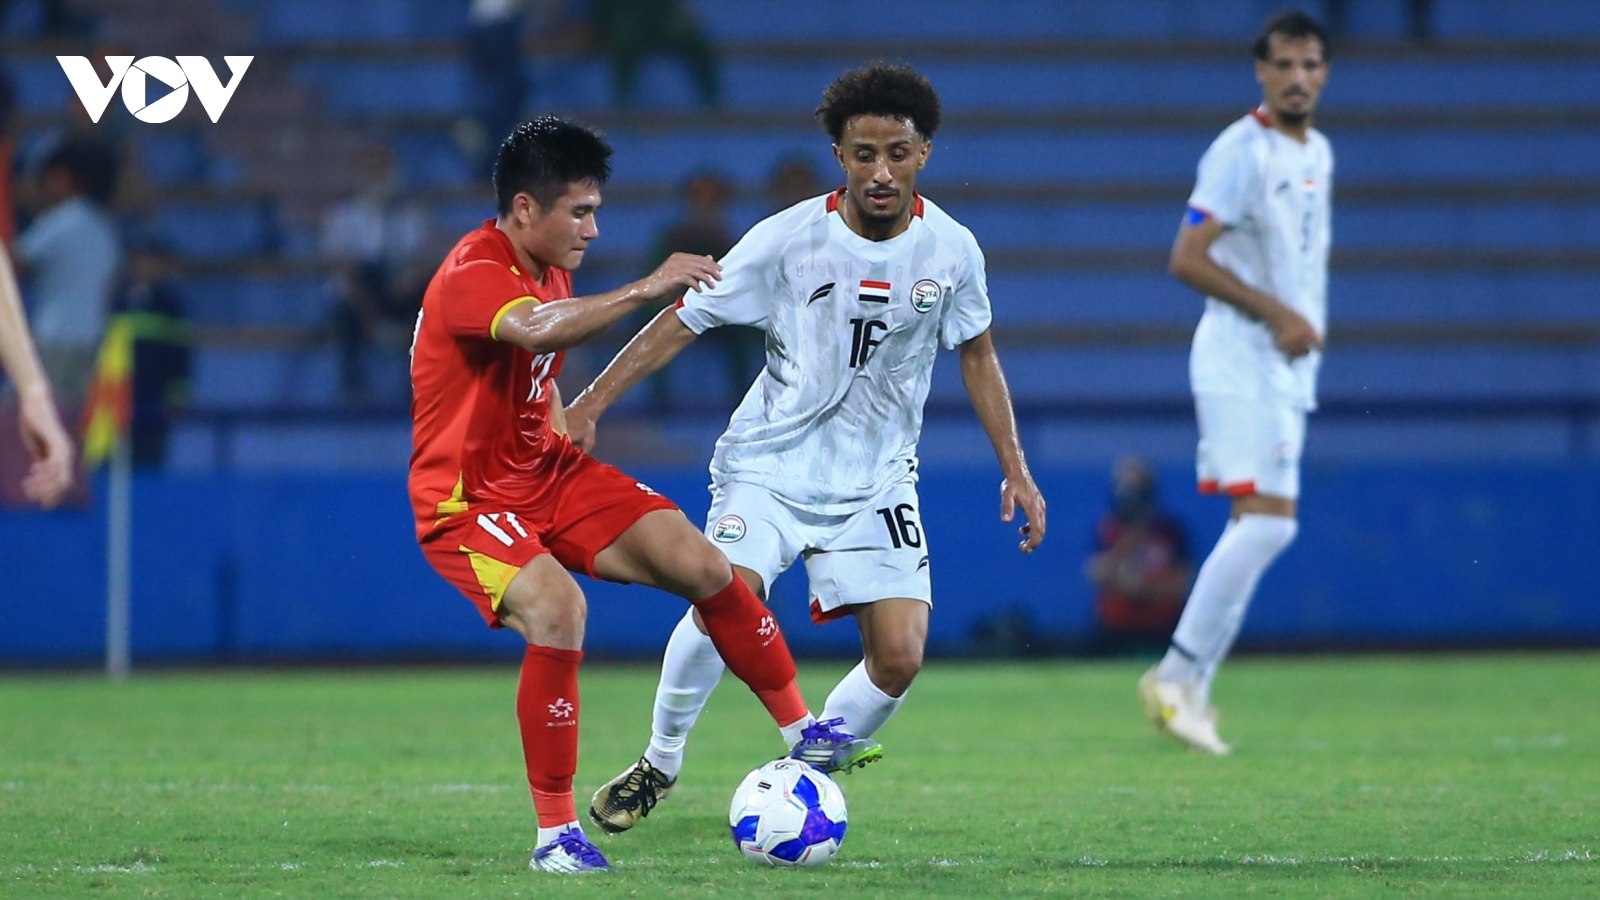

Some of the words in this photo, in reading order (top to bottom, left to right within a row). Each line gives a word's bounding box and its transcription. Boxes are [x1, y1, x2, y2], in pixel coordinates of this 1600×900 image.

[849, 318, 888, 368] 16
[476, 511, 529, 547] 17
[876, 503, 921, 549] 16
